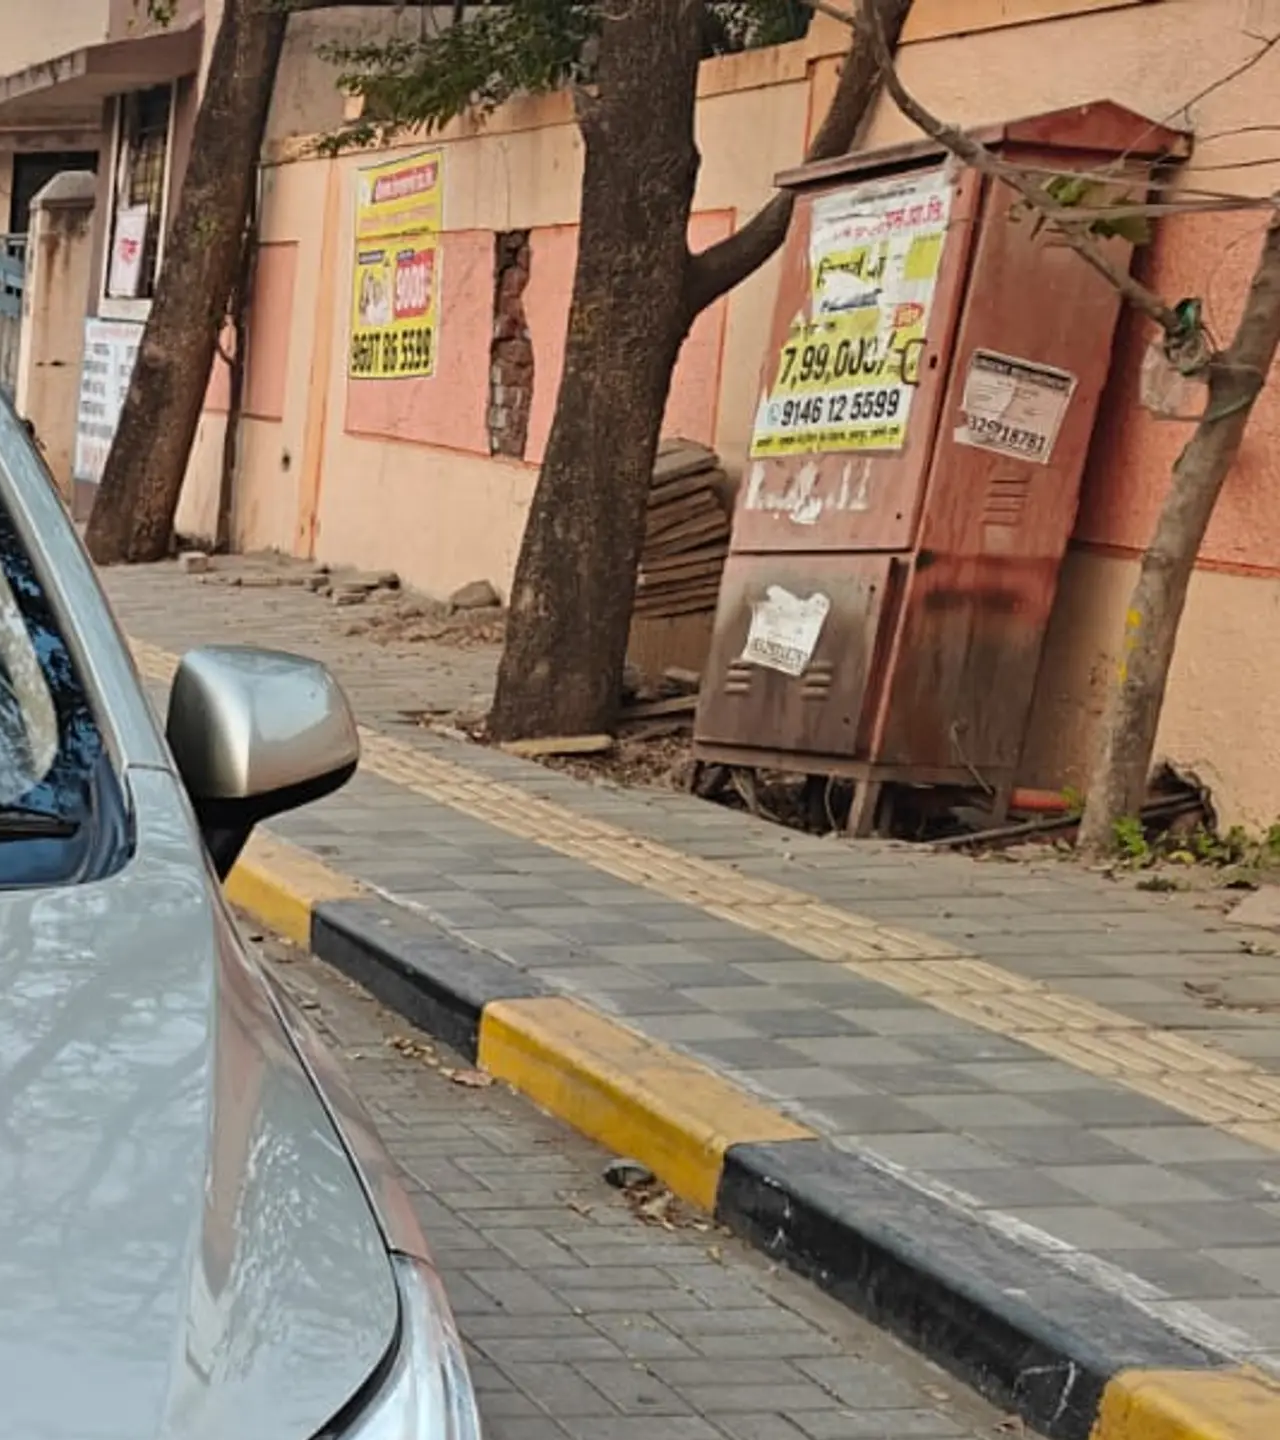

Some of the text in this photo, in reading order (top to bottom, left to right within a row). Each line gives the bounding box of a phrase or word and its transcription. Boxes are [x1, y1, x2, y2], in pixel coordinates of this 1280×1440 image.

[780, 389, 900, 426] 9146 12 5599
